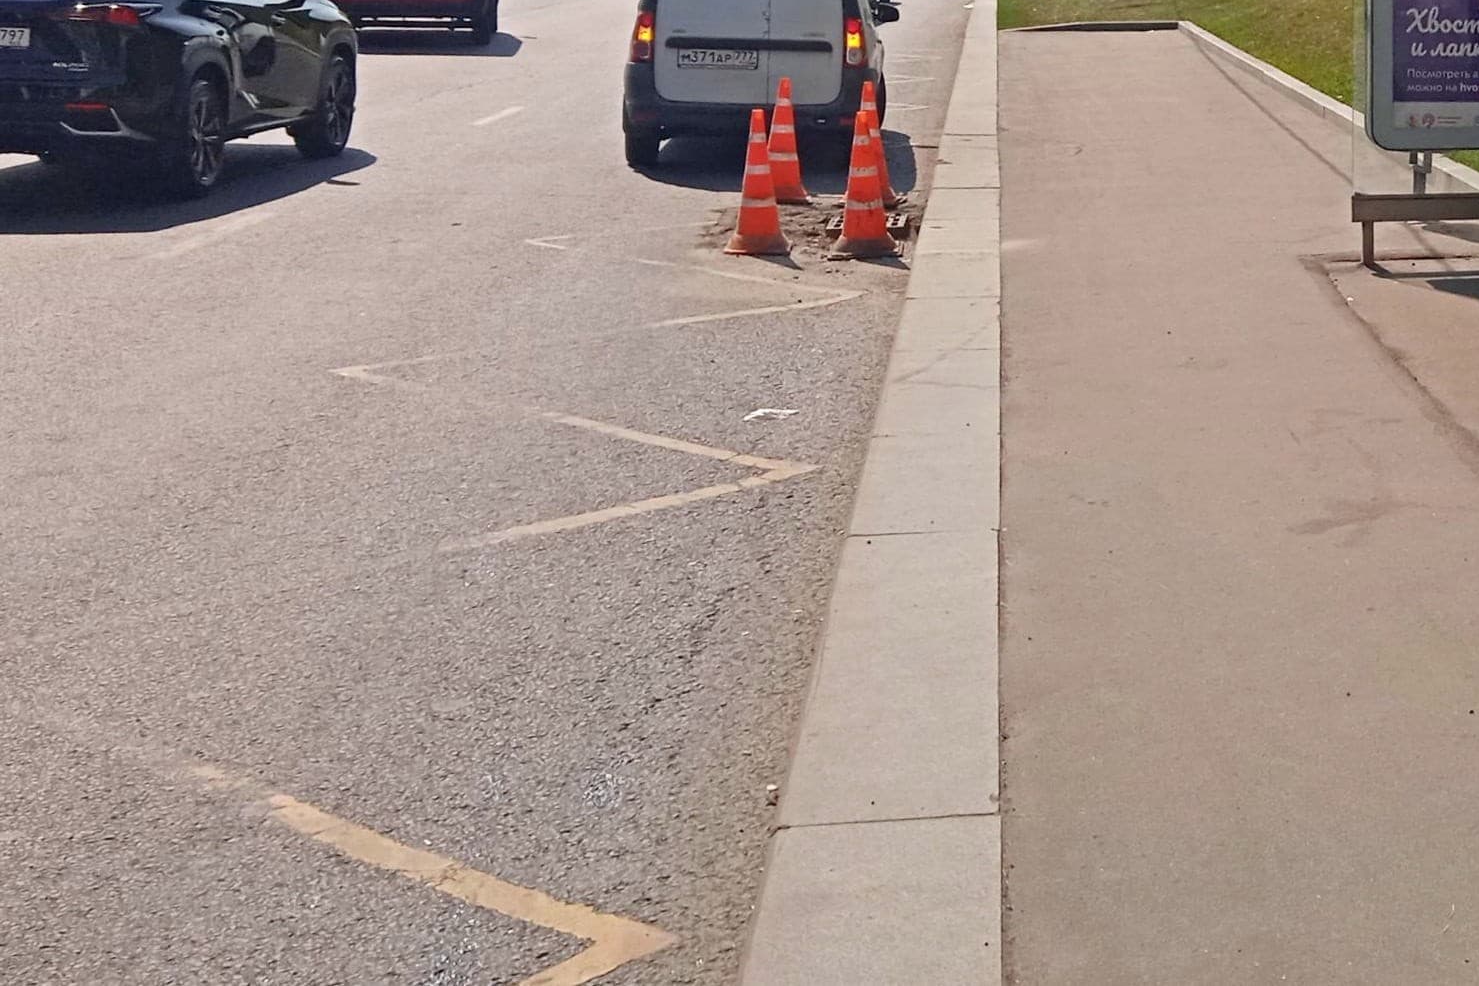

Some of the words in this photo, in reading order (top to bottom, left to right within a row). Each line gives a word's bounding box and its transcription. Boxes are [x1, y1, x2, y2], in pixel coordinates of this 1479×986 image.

[0, 29, 25, 41] 797
[1411, 42, 1427, 57] и
[1407, 68, 1471, 80] Посмотреть
[1407, 83, 1443, 93] можно
